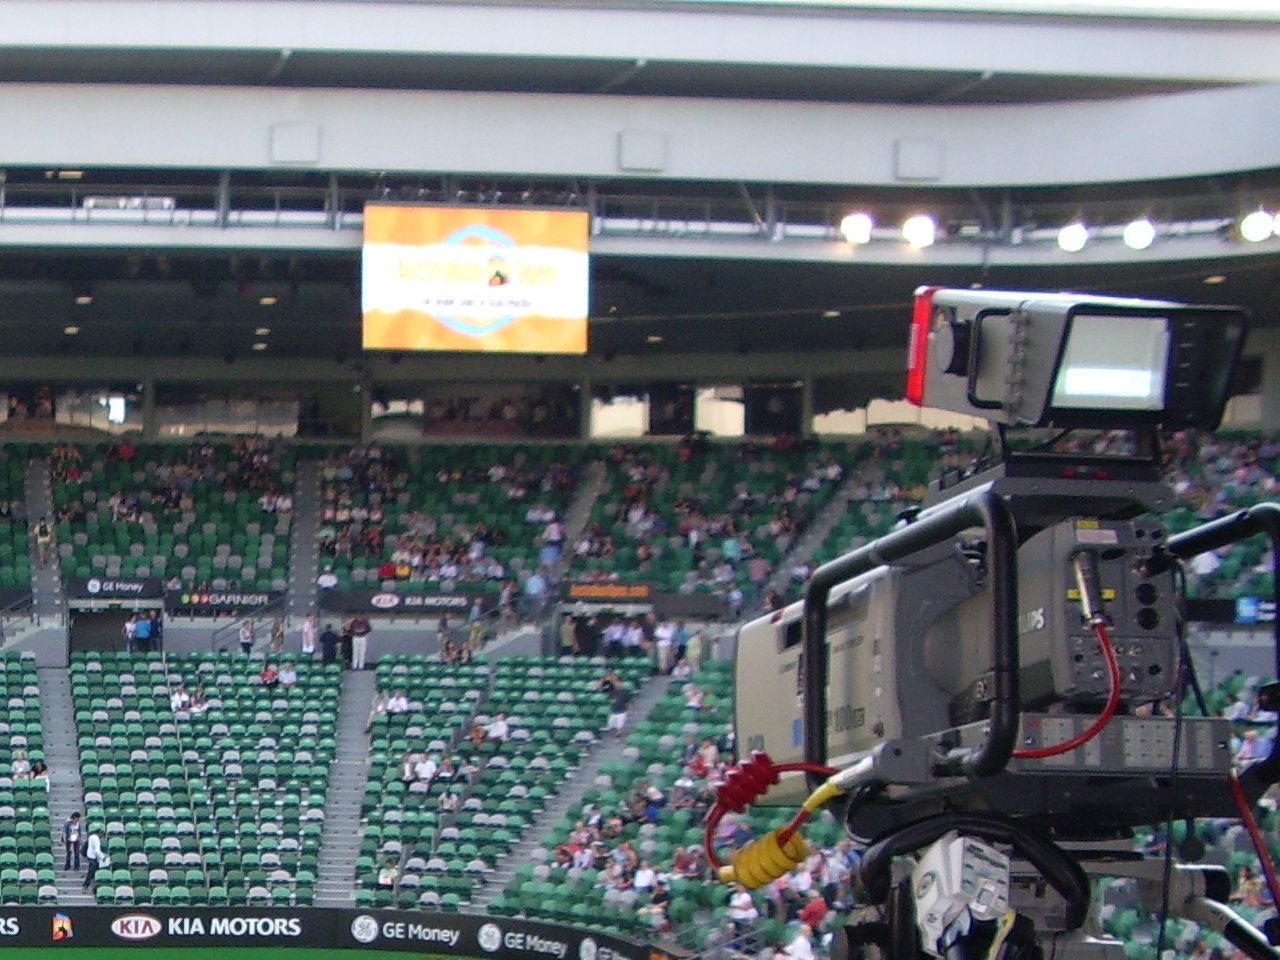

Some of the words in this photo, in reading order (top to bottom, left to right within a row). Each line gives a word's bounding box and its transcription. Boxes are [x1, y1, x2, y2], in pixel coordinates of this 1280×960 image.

[120, 922, 153, 934] KIA
[169, 918, 205, 935] KIA
[210, 918, 302, 936] MOTORS
[383, 922, 405, 939] GE
[408, 924, 460, 947] Money
[504, 932, 524, 950] GE
[525, 935, 569, 959] Money
